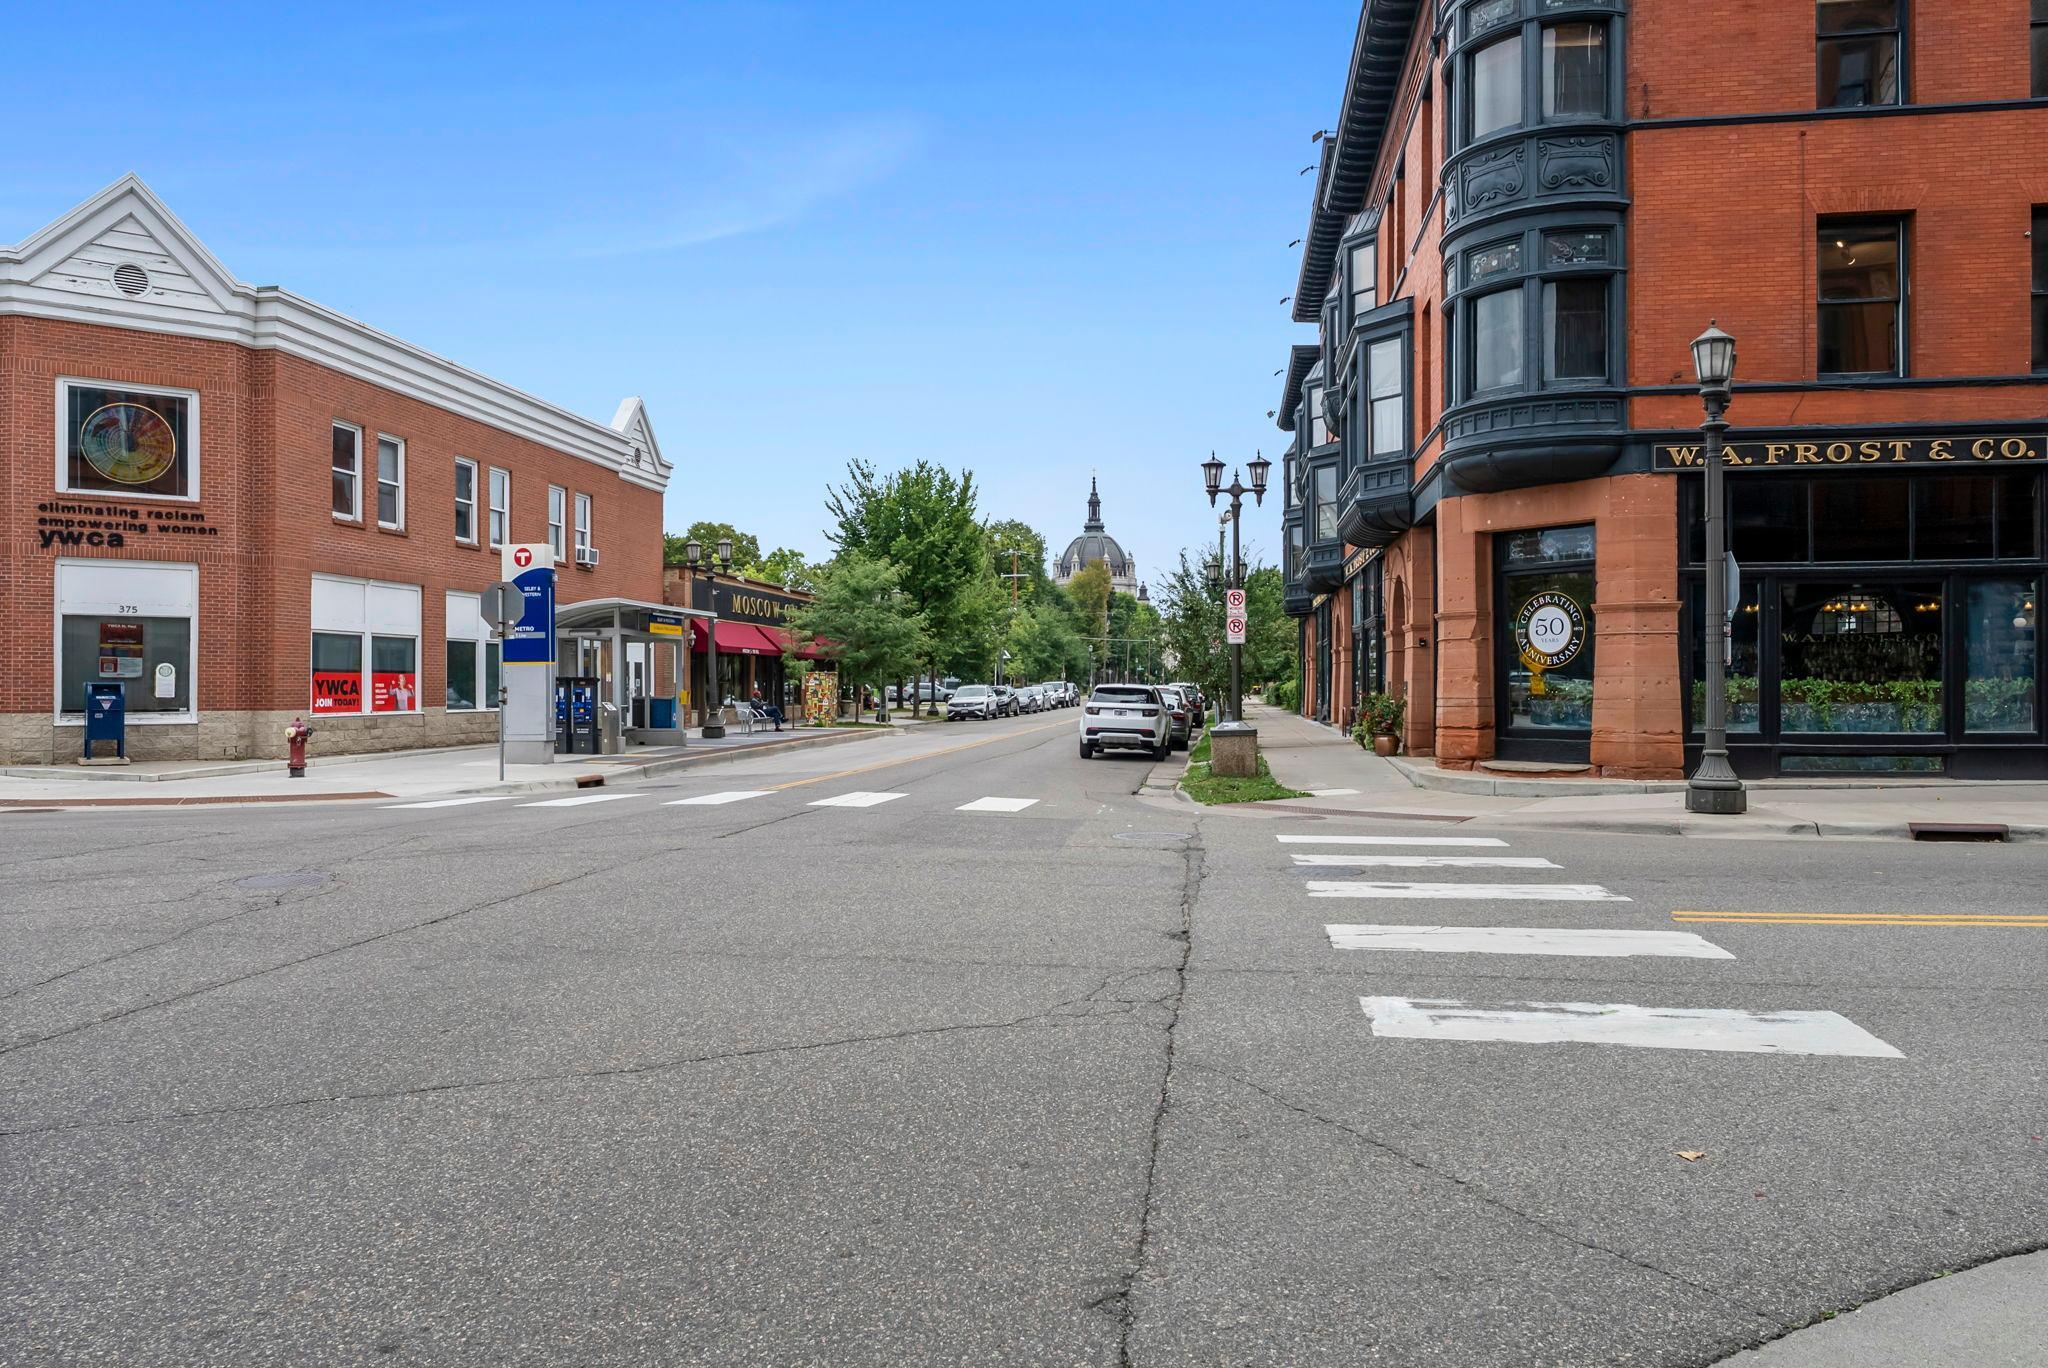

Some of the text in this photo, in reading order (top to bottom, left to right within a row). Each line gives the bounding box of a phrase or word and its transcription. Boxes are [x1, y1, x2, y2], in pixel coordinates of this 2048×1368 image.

[1764, 441, 1912, 464] FROST
[1929, 439, 1956, 460] &
[1971, 438, 2036, 461] CO.
[38, 502, 205, 522] eliminating racism
[38, 517, 218, 536] empowering women
[39, 530, 124, 548] ywca
[118, 605, 138, 614] 375
[732, 594, 780, 618] MOSCOW
[1520, 595, 1580, 624] CELEBRATING
[1535, 617, 1564, 636] 50
[1519, 636, 1580, 665] ANNIVERSARY
[315, 679, 360, 696] YWCA
[315, 698, 360, 707] JOIN TODAY!
